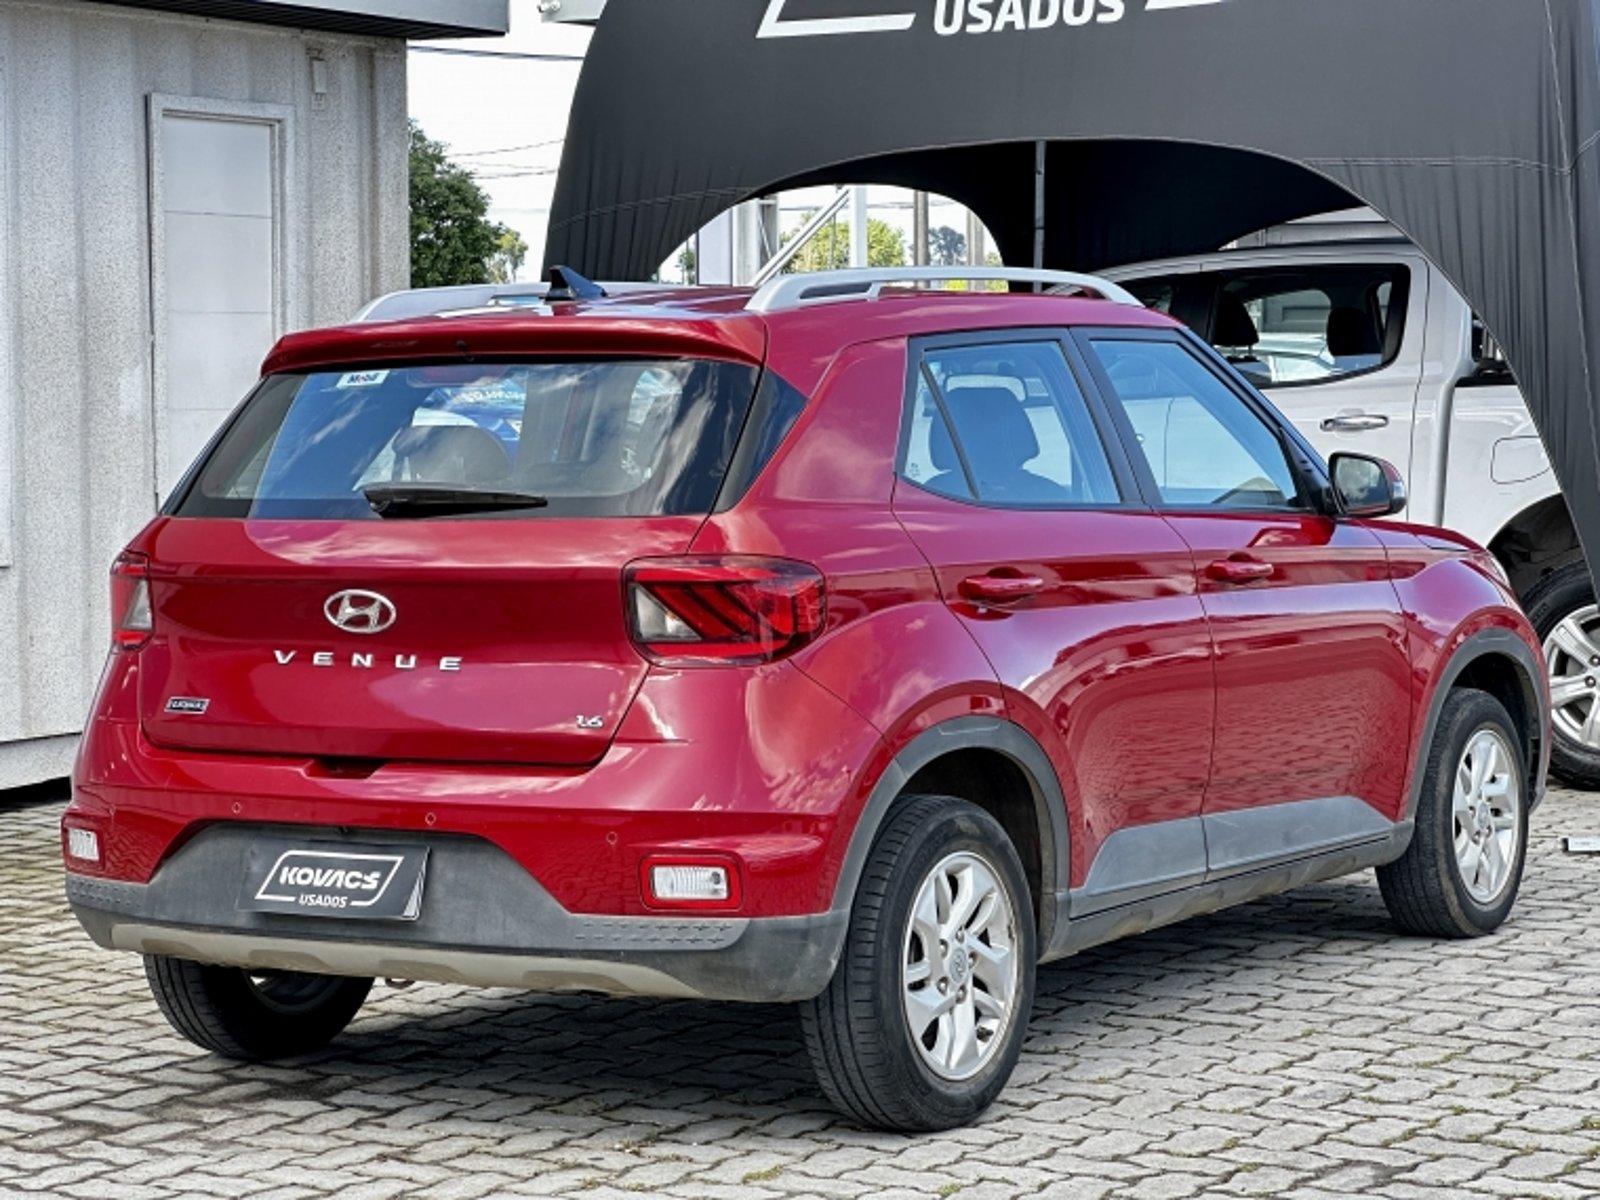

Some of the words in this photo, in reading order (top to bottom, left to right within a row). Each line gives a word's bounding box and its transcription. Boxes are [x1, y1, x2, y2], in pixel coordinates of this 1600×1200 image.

[934, 0, 1125, 36] USADOS
[273, 650, 463, 671] VENUE
[279, 866, 382, 890] KOVACS
[298, 893, 348, 908] USADOS
